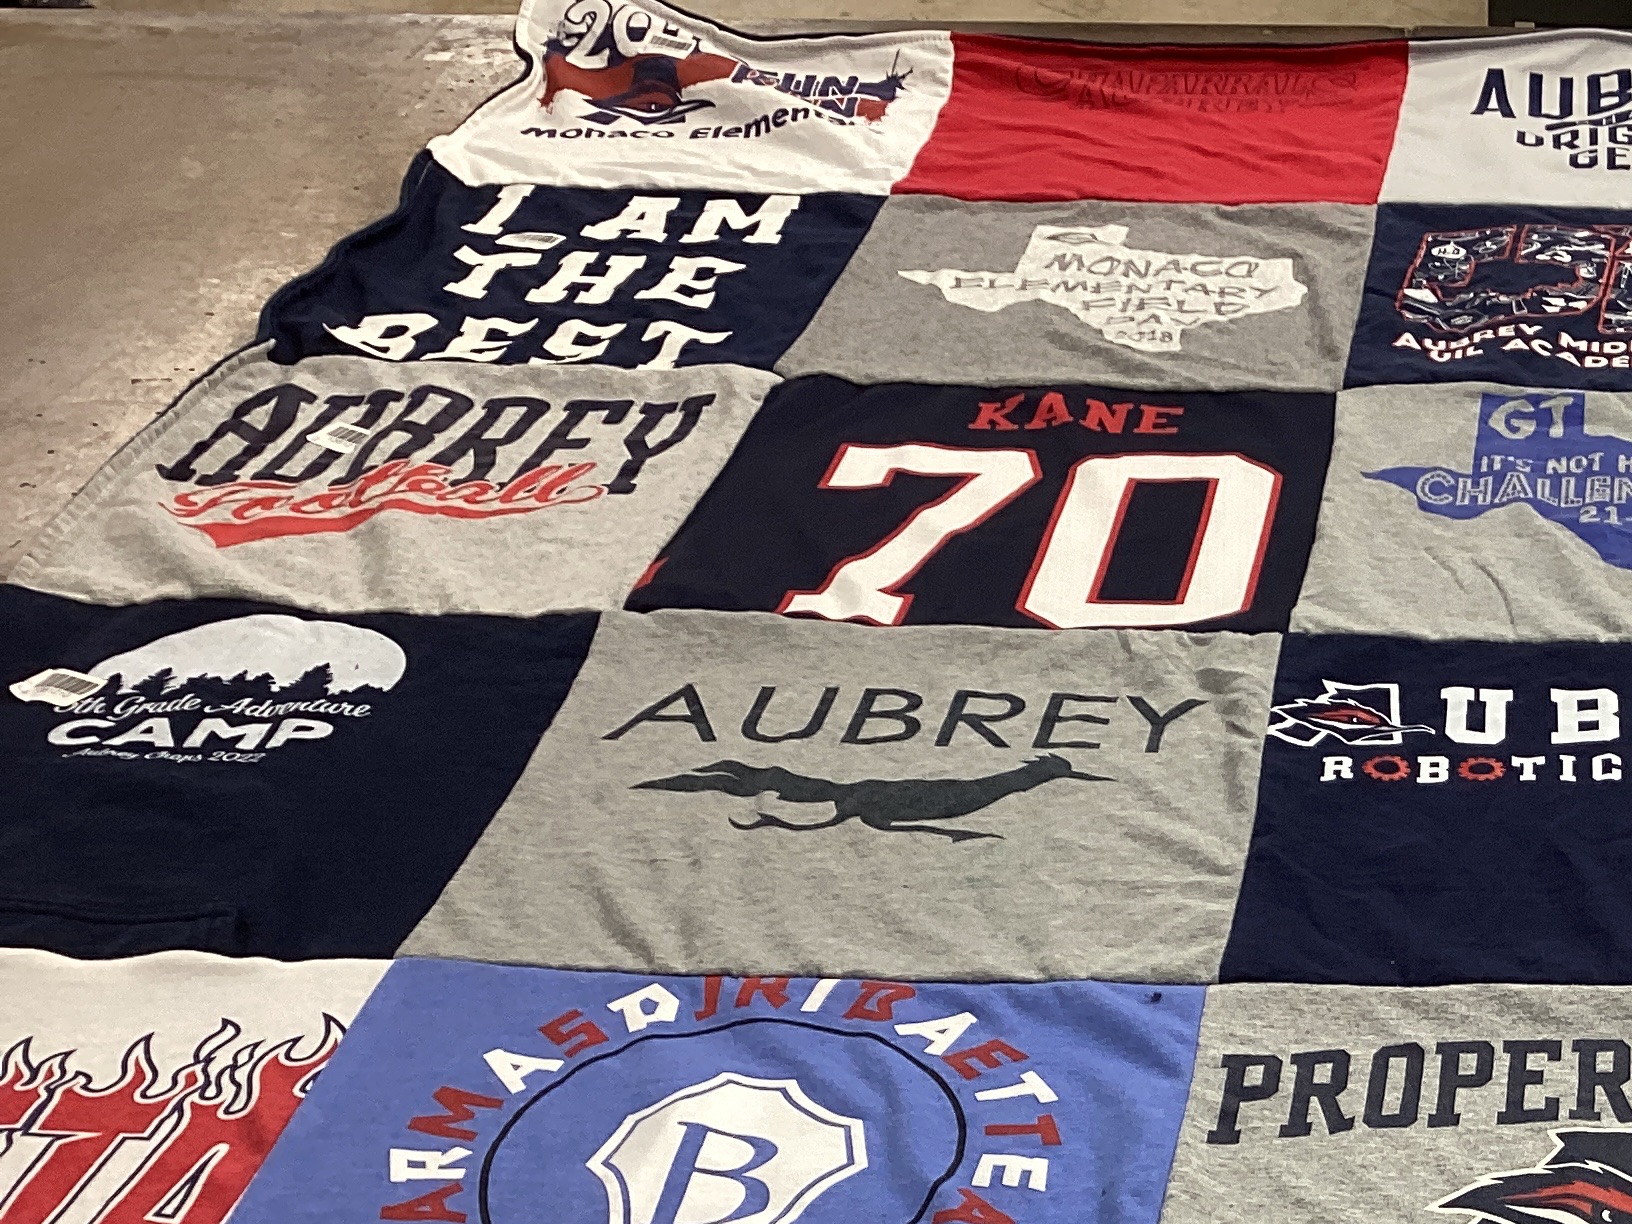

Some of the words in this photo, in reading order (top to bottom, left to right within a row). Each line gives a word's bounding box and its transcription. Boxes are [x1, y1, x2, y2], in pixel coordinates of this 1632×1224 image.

[521, 126, 675, 140] Monaco
[689, 106, 856, 140] Elemen
[462, 184, 537, 236] I
[580, 195, 800, 244] AM
[443, 245, 747, 309] THE
[1046, 253, 1259, 279] MONACO
[949, 276, 1282, 299] ELEMENTARY
[1083, 297, 1250, 316] FIELD
[322, 313, 733, 370] BEST
[1393, 324, 1543, 351] AUBREY
[968, 391, 1185, 434] KANE
[1488, 394, 1575, 440] GT
[1481, 454, 1533, 474] IT'S
[1546, 453, 1605, 476] NOT
[775, 441, 1283, 629] 70
[107, 694, 201, 722] Grade
[205, 697, 372, 720] Adventure
[601, 683, 1208, 753] AUBREY
[47, 717, 334, 751] CAMP
